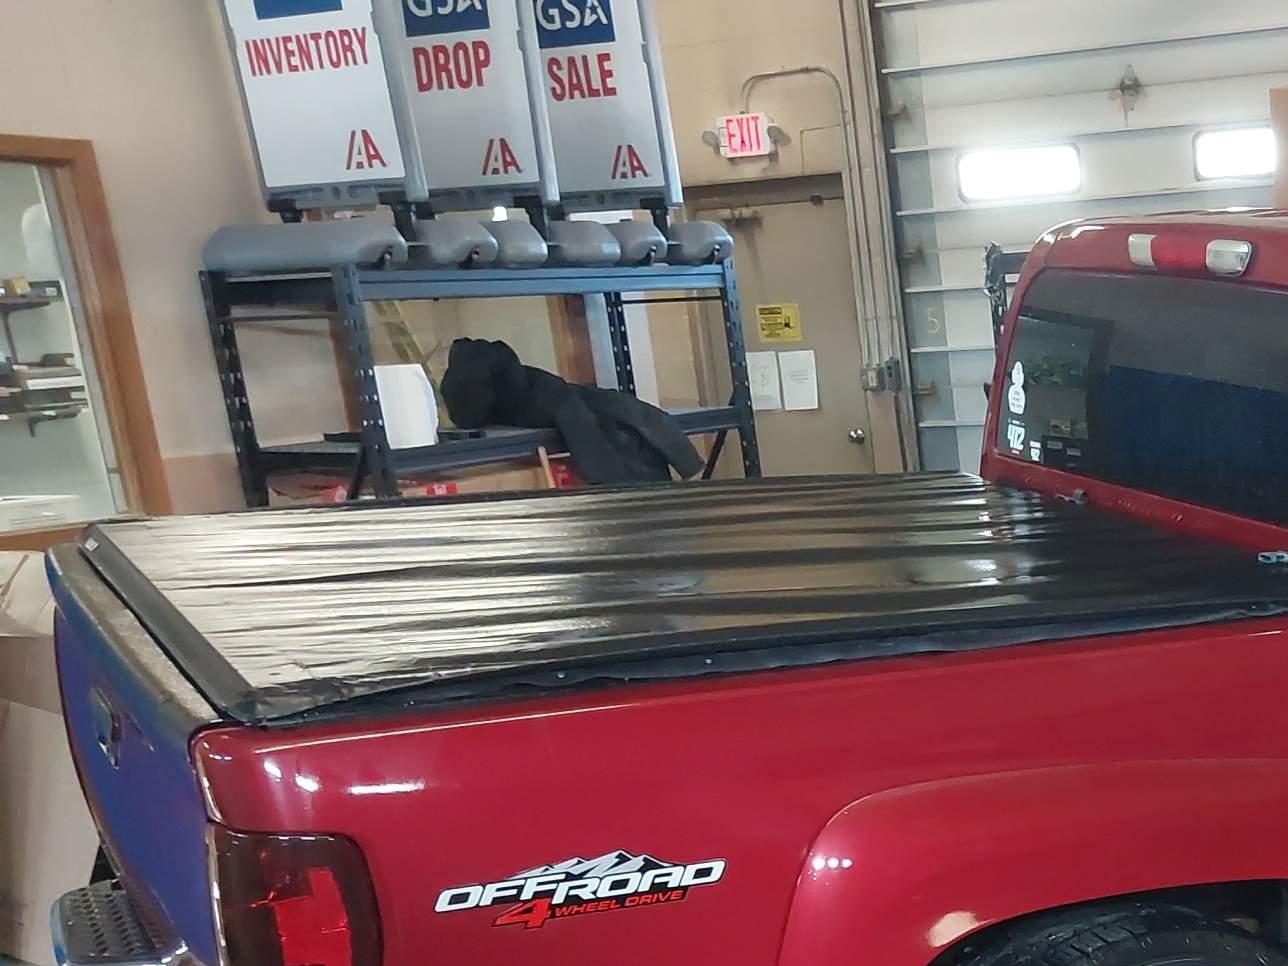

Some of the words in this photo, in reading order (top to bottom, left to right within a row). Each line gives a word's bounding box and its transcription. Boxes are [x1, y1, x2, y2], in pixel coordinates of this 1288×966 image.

[246, 27, 369, 77] INVENTORY
[412, 40, 492, 93] DROP
[547, 52, 617, 102] SALE
[726, 116, 762, 154] EXIT
[491, 898, 552, 930] 4
[554, 899, 621, 917] WHEEL
[624, 889, 683, 908] DRIVE
